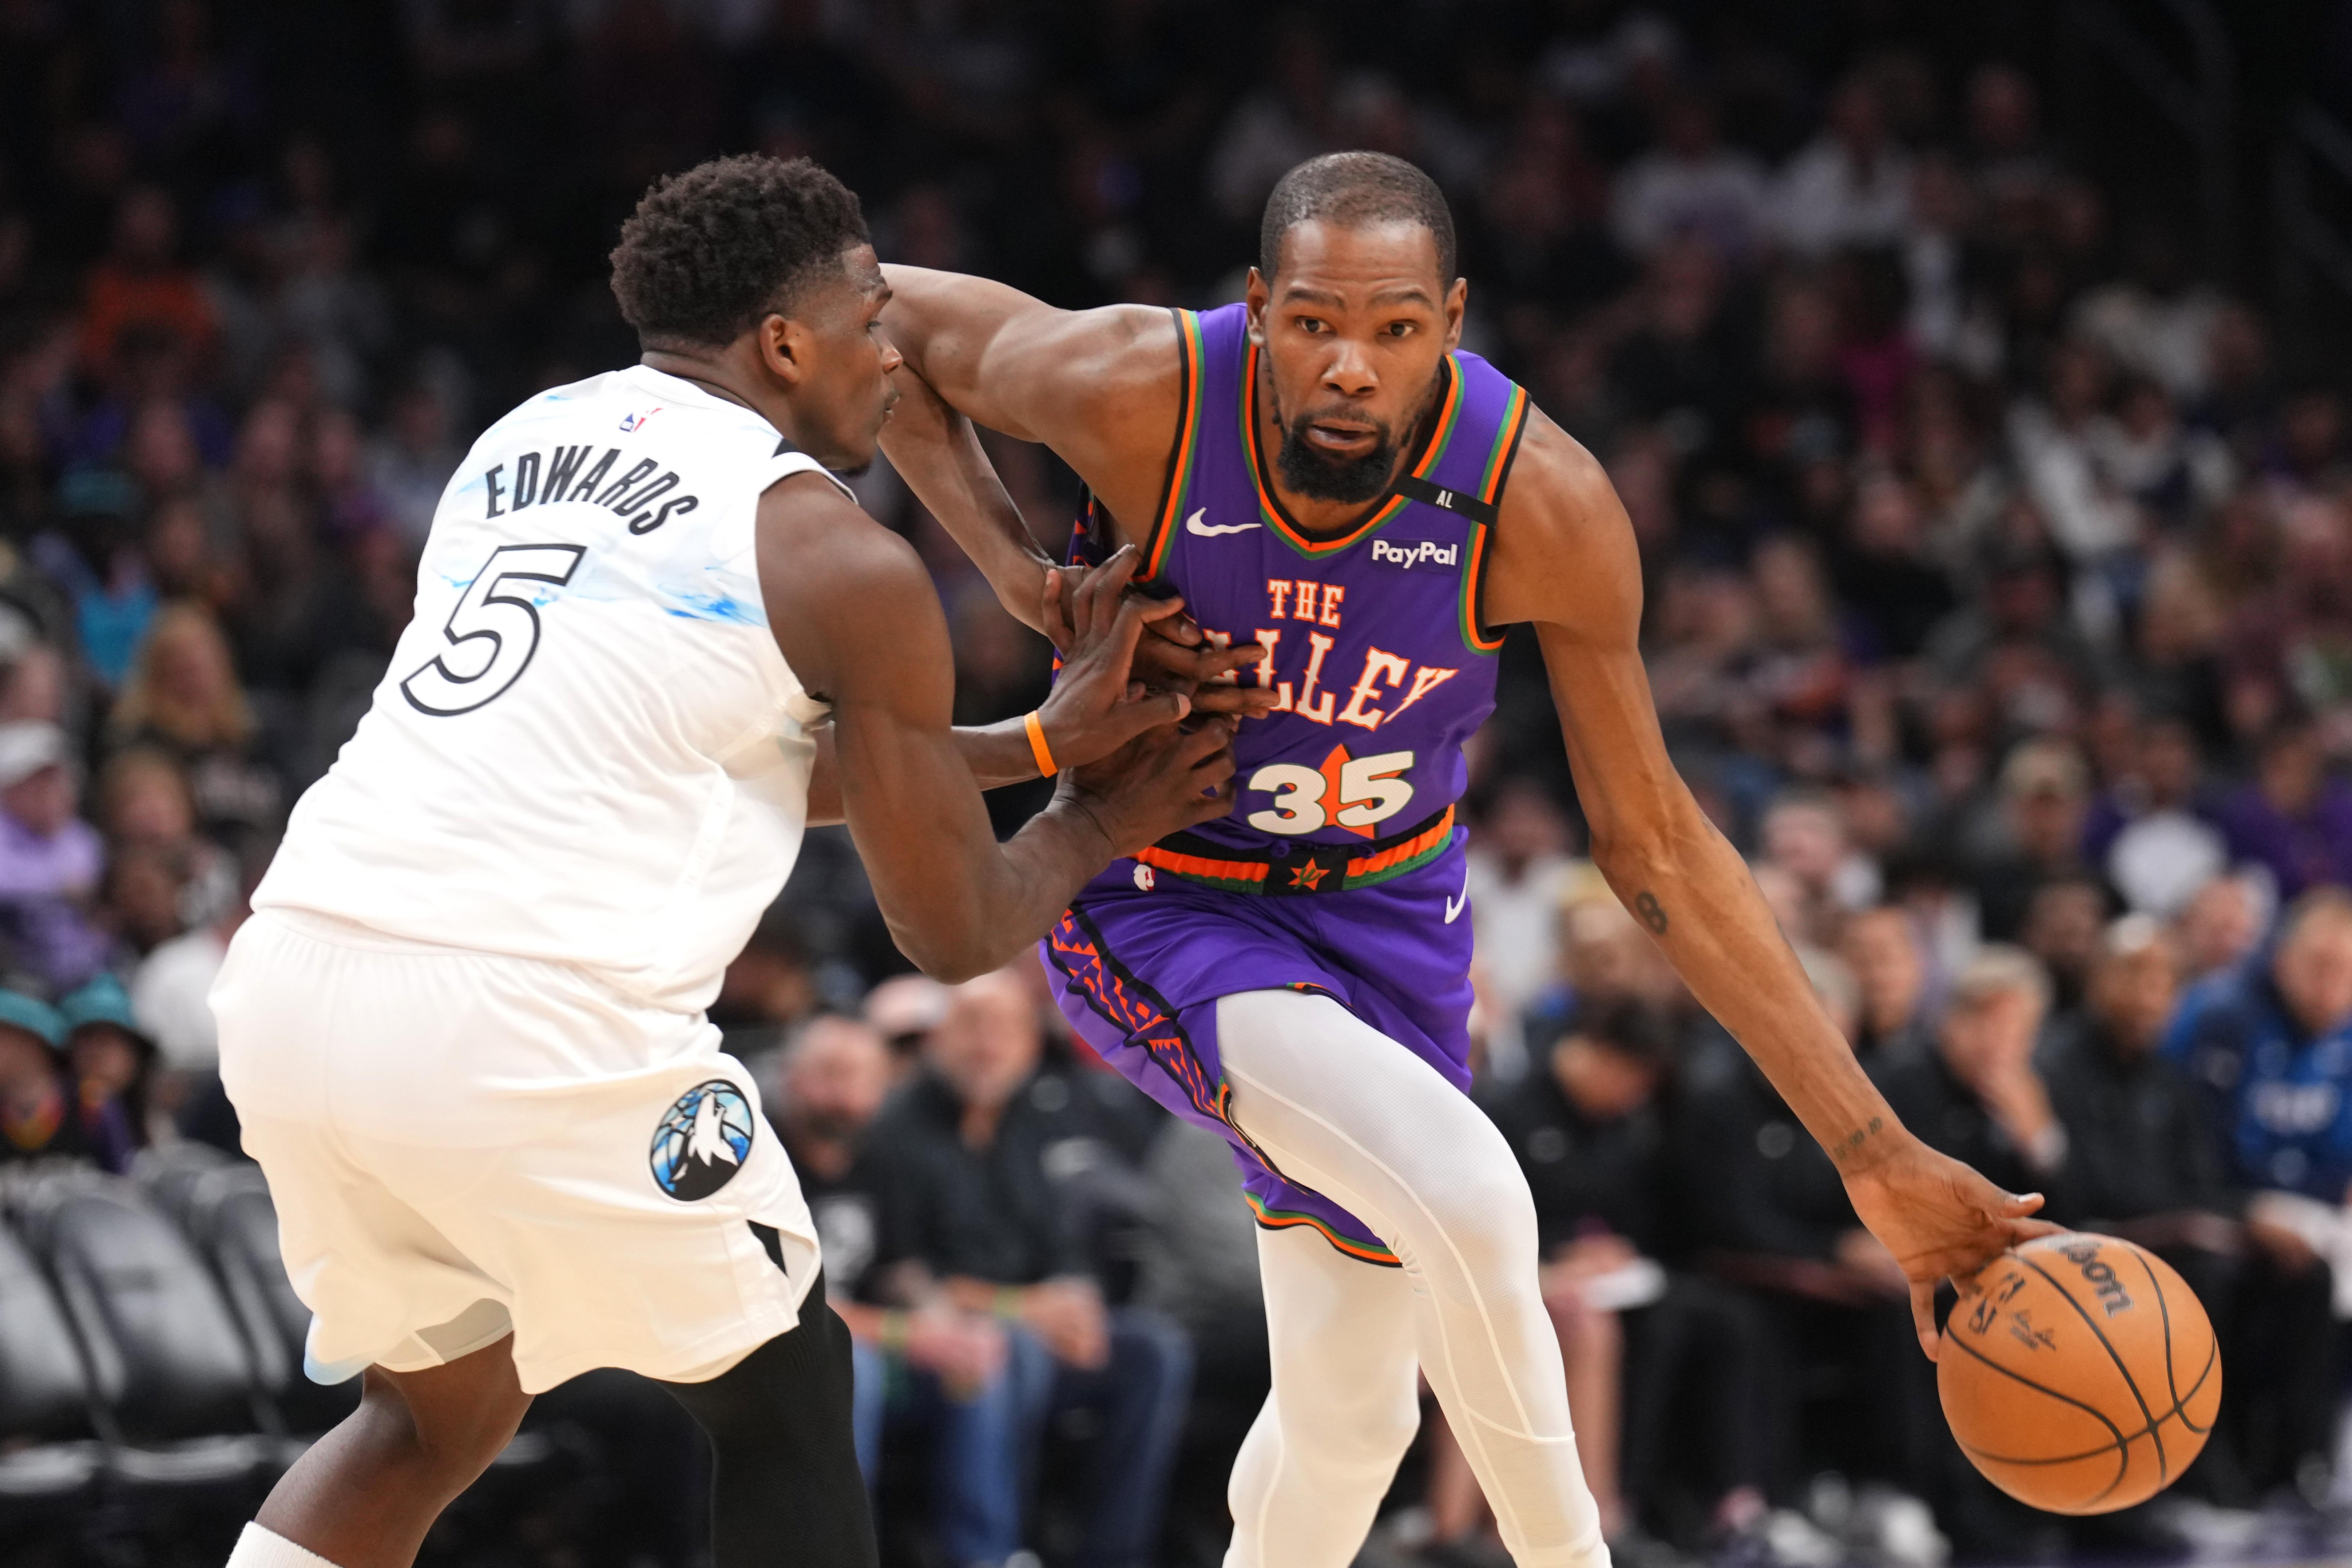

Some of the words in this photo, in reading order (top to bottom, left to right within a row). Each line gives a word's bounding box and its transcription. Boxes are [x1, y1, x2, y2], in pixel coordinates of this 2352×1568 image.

[486, 445, 699, 536] EDWARDS
[1435, 489, 1453, 509] AL
[1372, 540, 1458, 569] PayPal
[400, 543, 588, 717] 5
[1267, 579, 1345, 629] THE
[1201, 628, 1459, 732] LLEY
[1246, 750, 1415, 835] 35
[1635, 892, 1668, 935] 8
